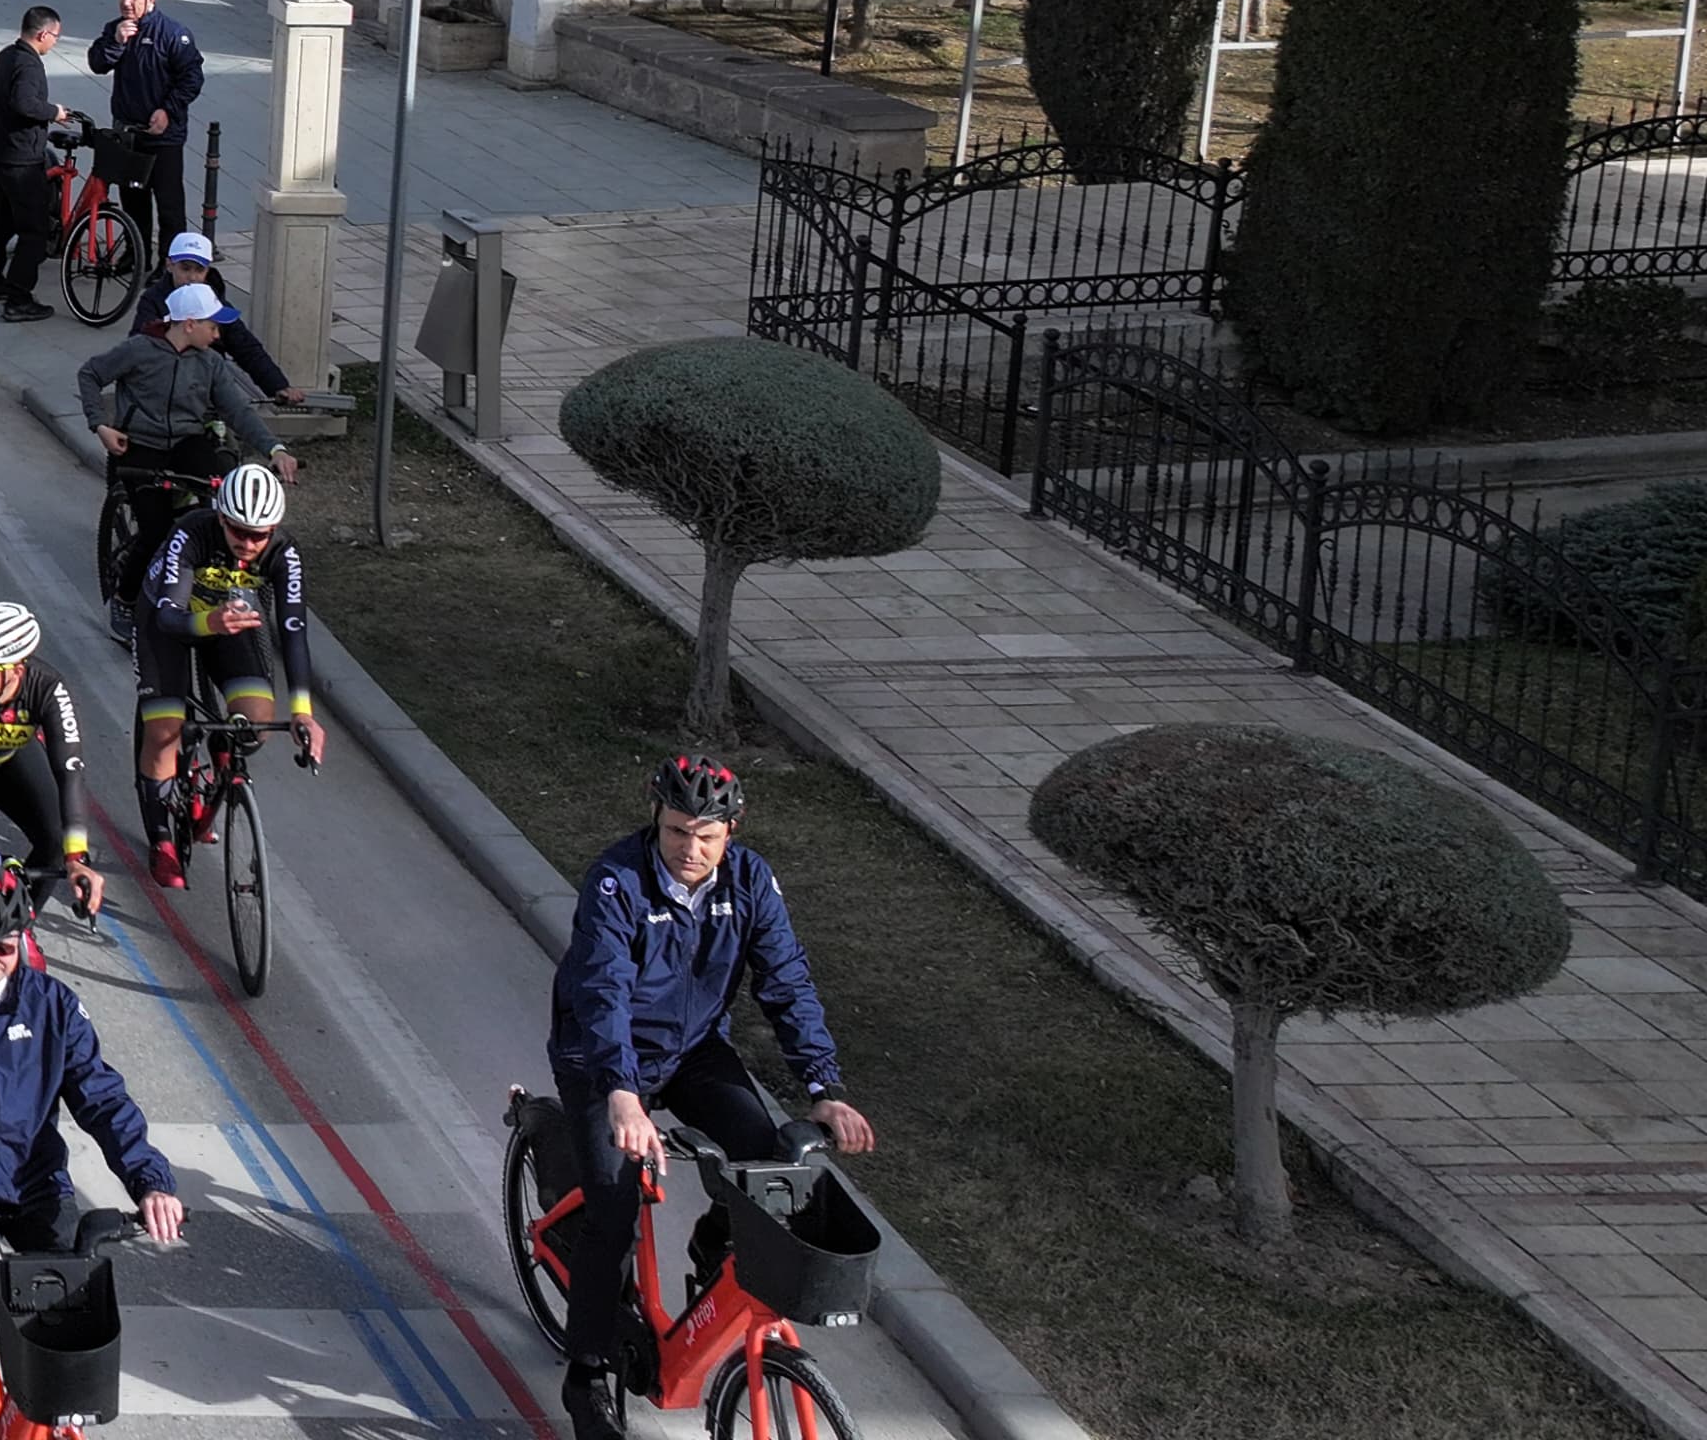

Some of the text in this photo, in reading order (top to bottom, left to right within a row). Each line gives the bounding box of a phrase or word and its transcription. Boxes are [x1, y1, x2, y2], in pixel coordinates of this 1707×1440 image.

[164, 528, 190, 585] KONYA
[284, 546, 302, 604] KONYA
[53, 682, 81, 743] KONYA
